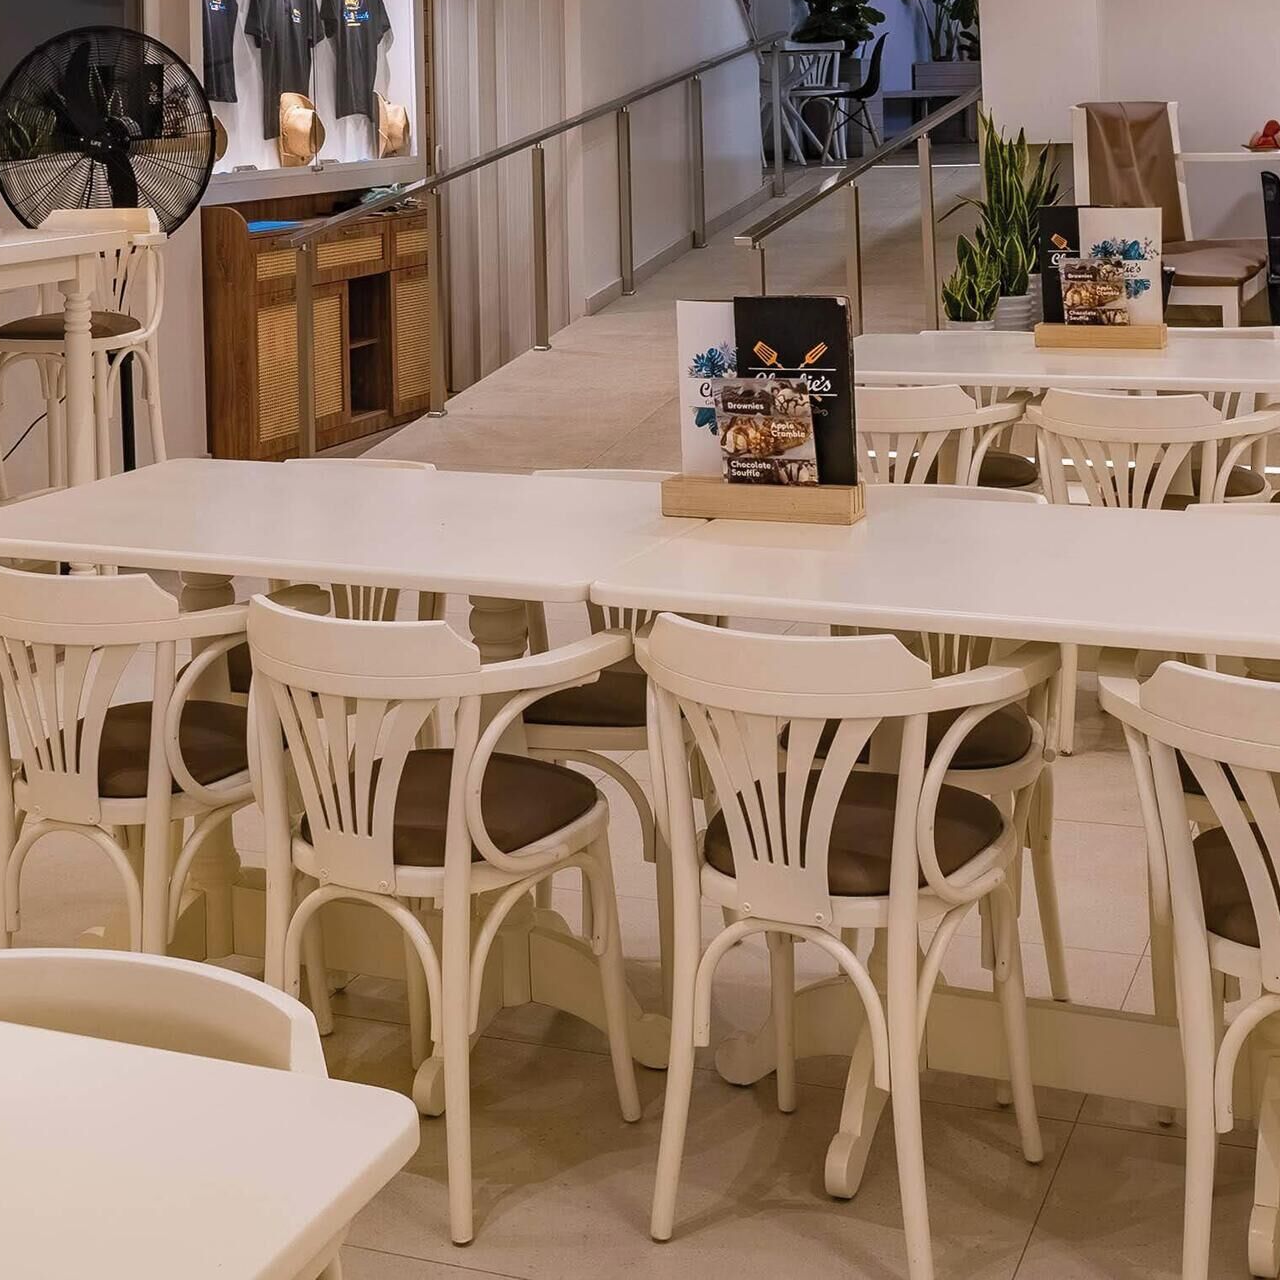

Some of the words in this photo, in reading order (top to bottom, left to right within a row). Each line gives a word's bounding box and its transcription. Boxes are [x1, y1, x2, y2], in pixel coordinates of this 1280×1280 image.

[727, 402, 764, 410] Brownies
[731, 460, 772, 470] Chocolate
[732, 470, 760, 478] Souffle
